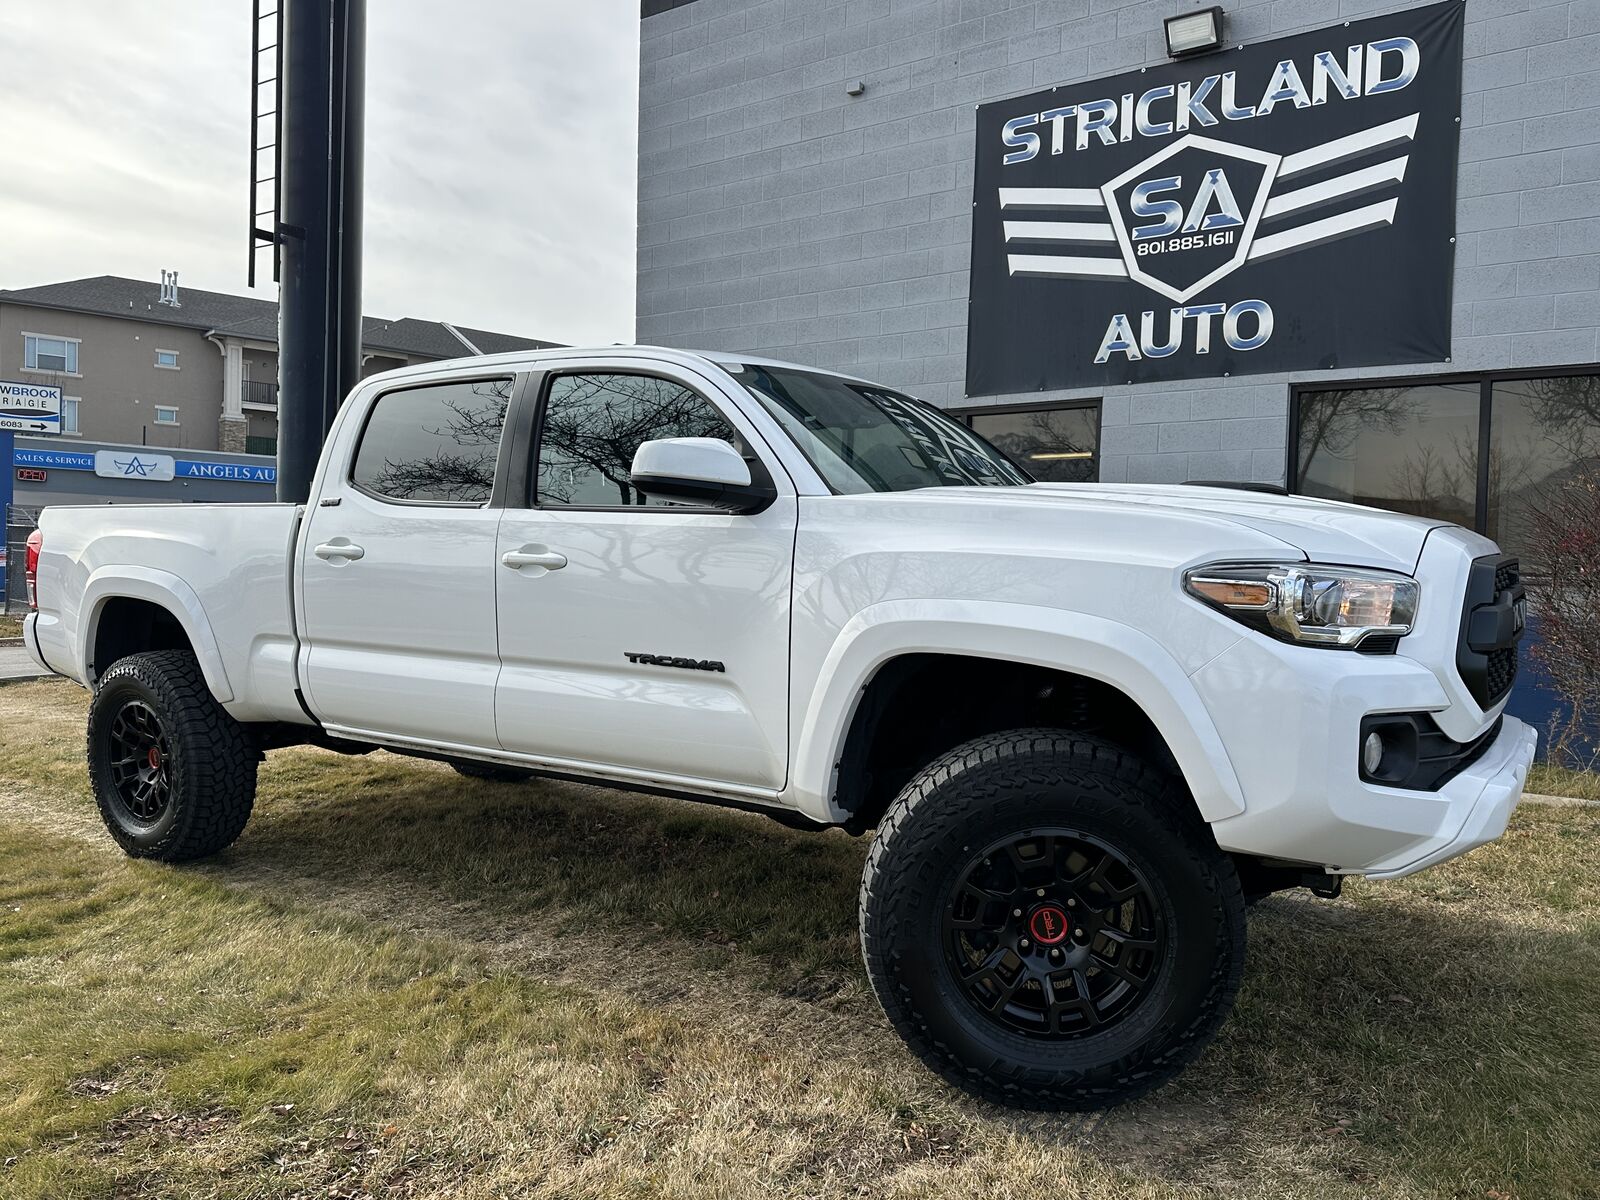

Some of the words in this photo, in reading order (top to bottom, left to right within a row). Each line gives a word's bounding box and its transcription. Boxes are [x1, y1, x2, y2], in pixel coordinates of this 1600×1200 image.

[1002, 36, 1421, 166] STRICKLAND
[1130, 168, 1244, 241] SA
[1137, 230, 1234, 257] 801.885.1611
[1093, 299, 1274, 364] AUTO
[0, 420, 23, 428] 6083
[16, 453, 44, 463] SALES
[45, 455, 53, 463] &
[55, 456, 93, 466] SERVICE
[18, 469, 46, 480] OPEN
[188, 464, 250, 479] ANGELS
[254, 469, 275, 480] AU
[623, 651, 726, 673] TACOMA
